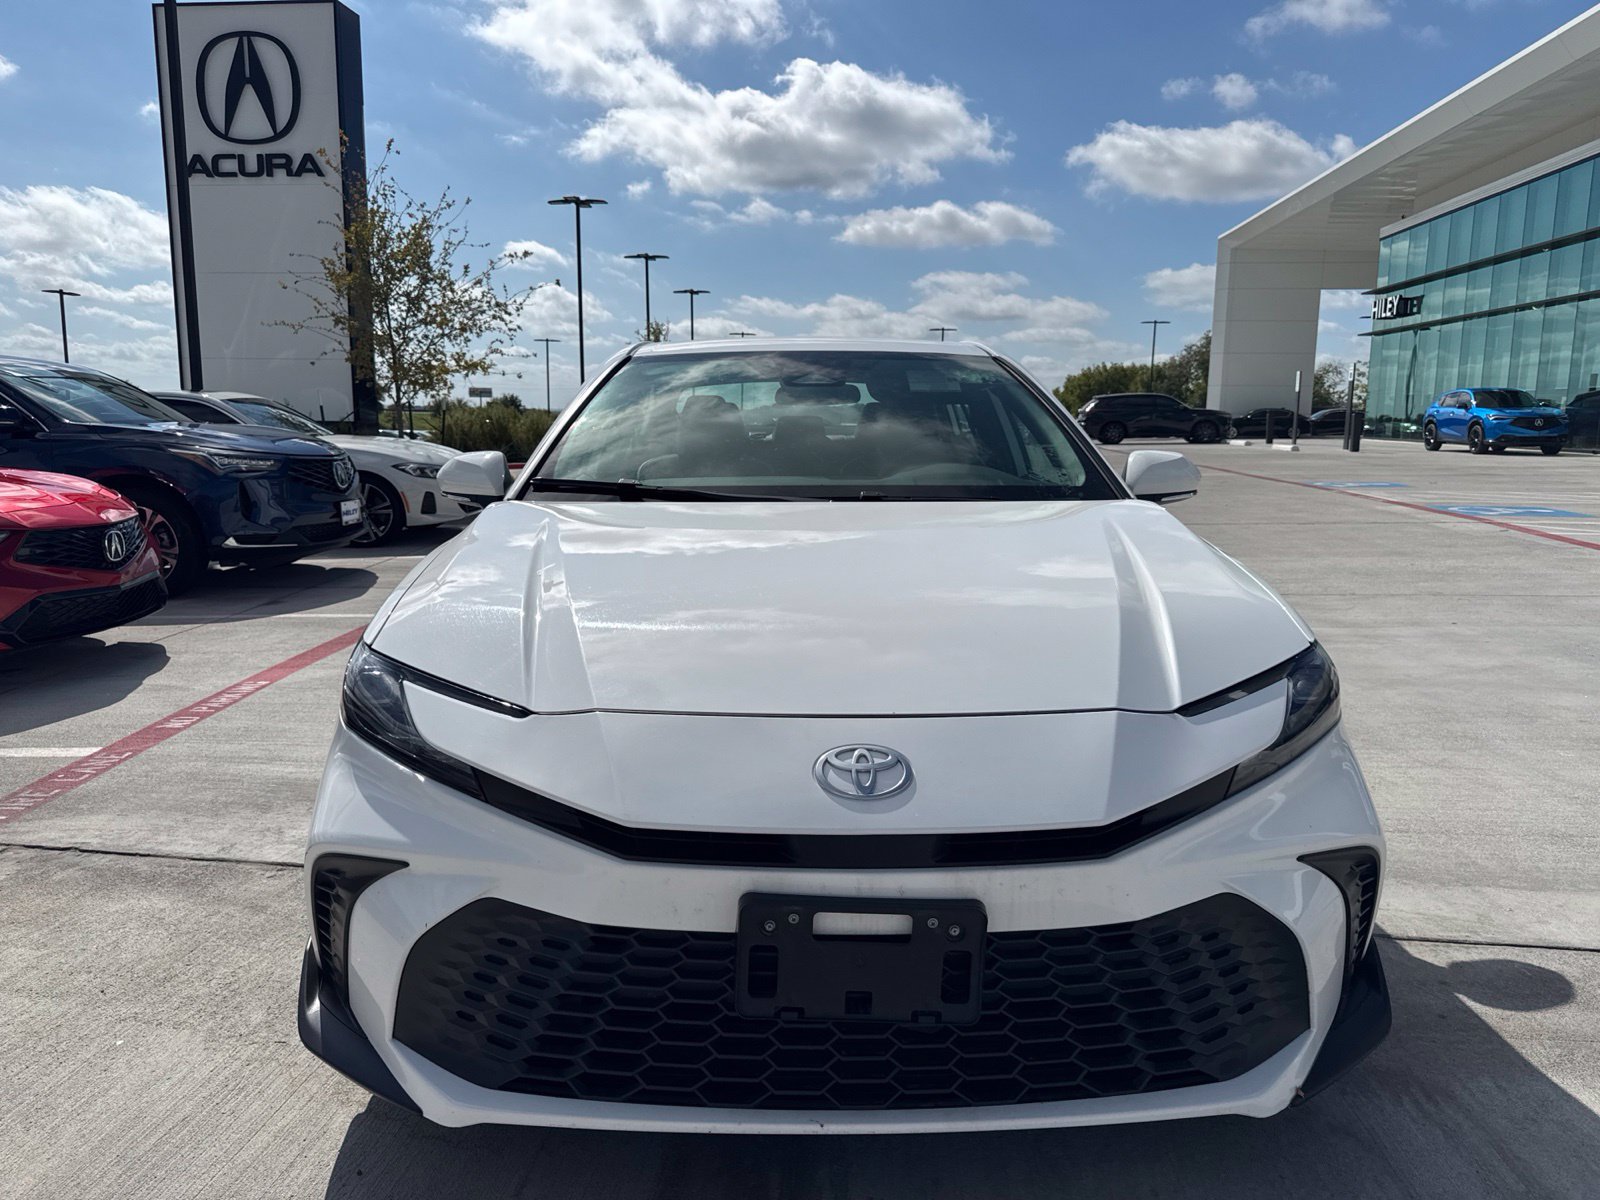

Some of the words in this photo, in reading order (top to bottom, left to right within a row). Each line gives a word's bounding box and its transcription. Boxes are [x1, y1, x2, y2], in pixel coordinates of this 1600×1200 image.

[187, 153, 326, 178] ACURA
[1371, 294, 1400, 320] HILEY
[0, 789, 61, 820] IRE
[48, 752, 133, 782] LANE
[155, 716, 200, 728] NO
[189, 681, 270, 712] PARKING
